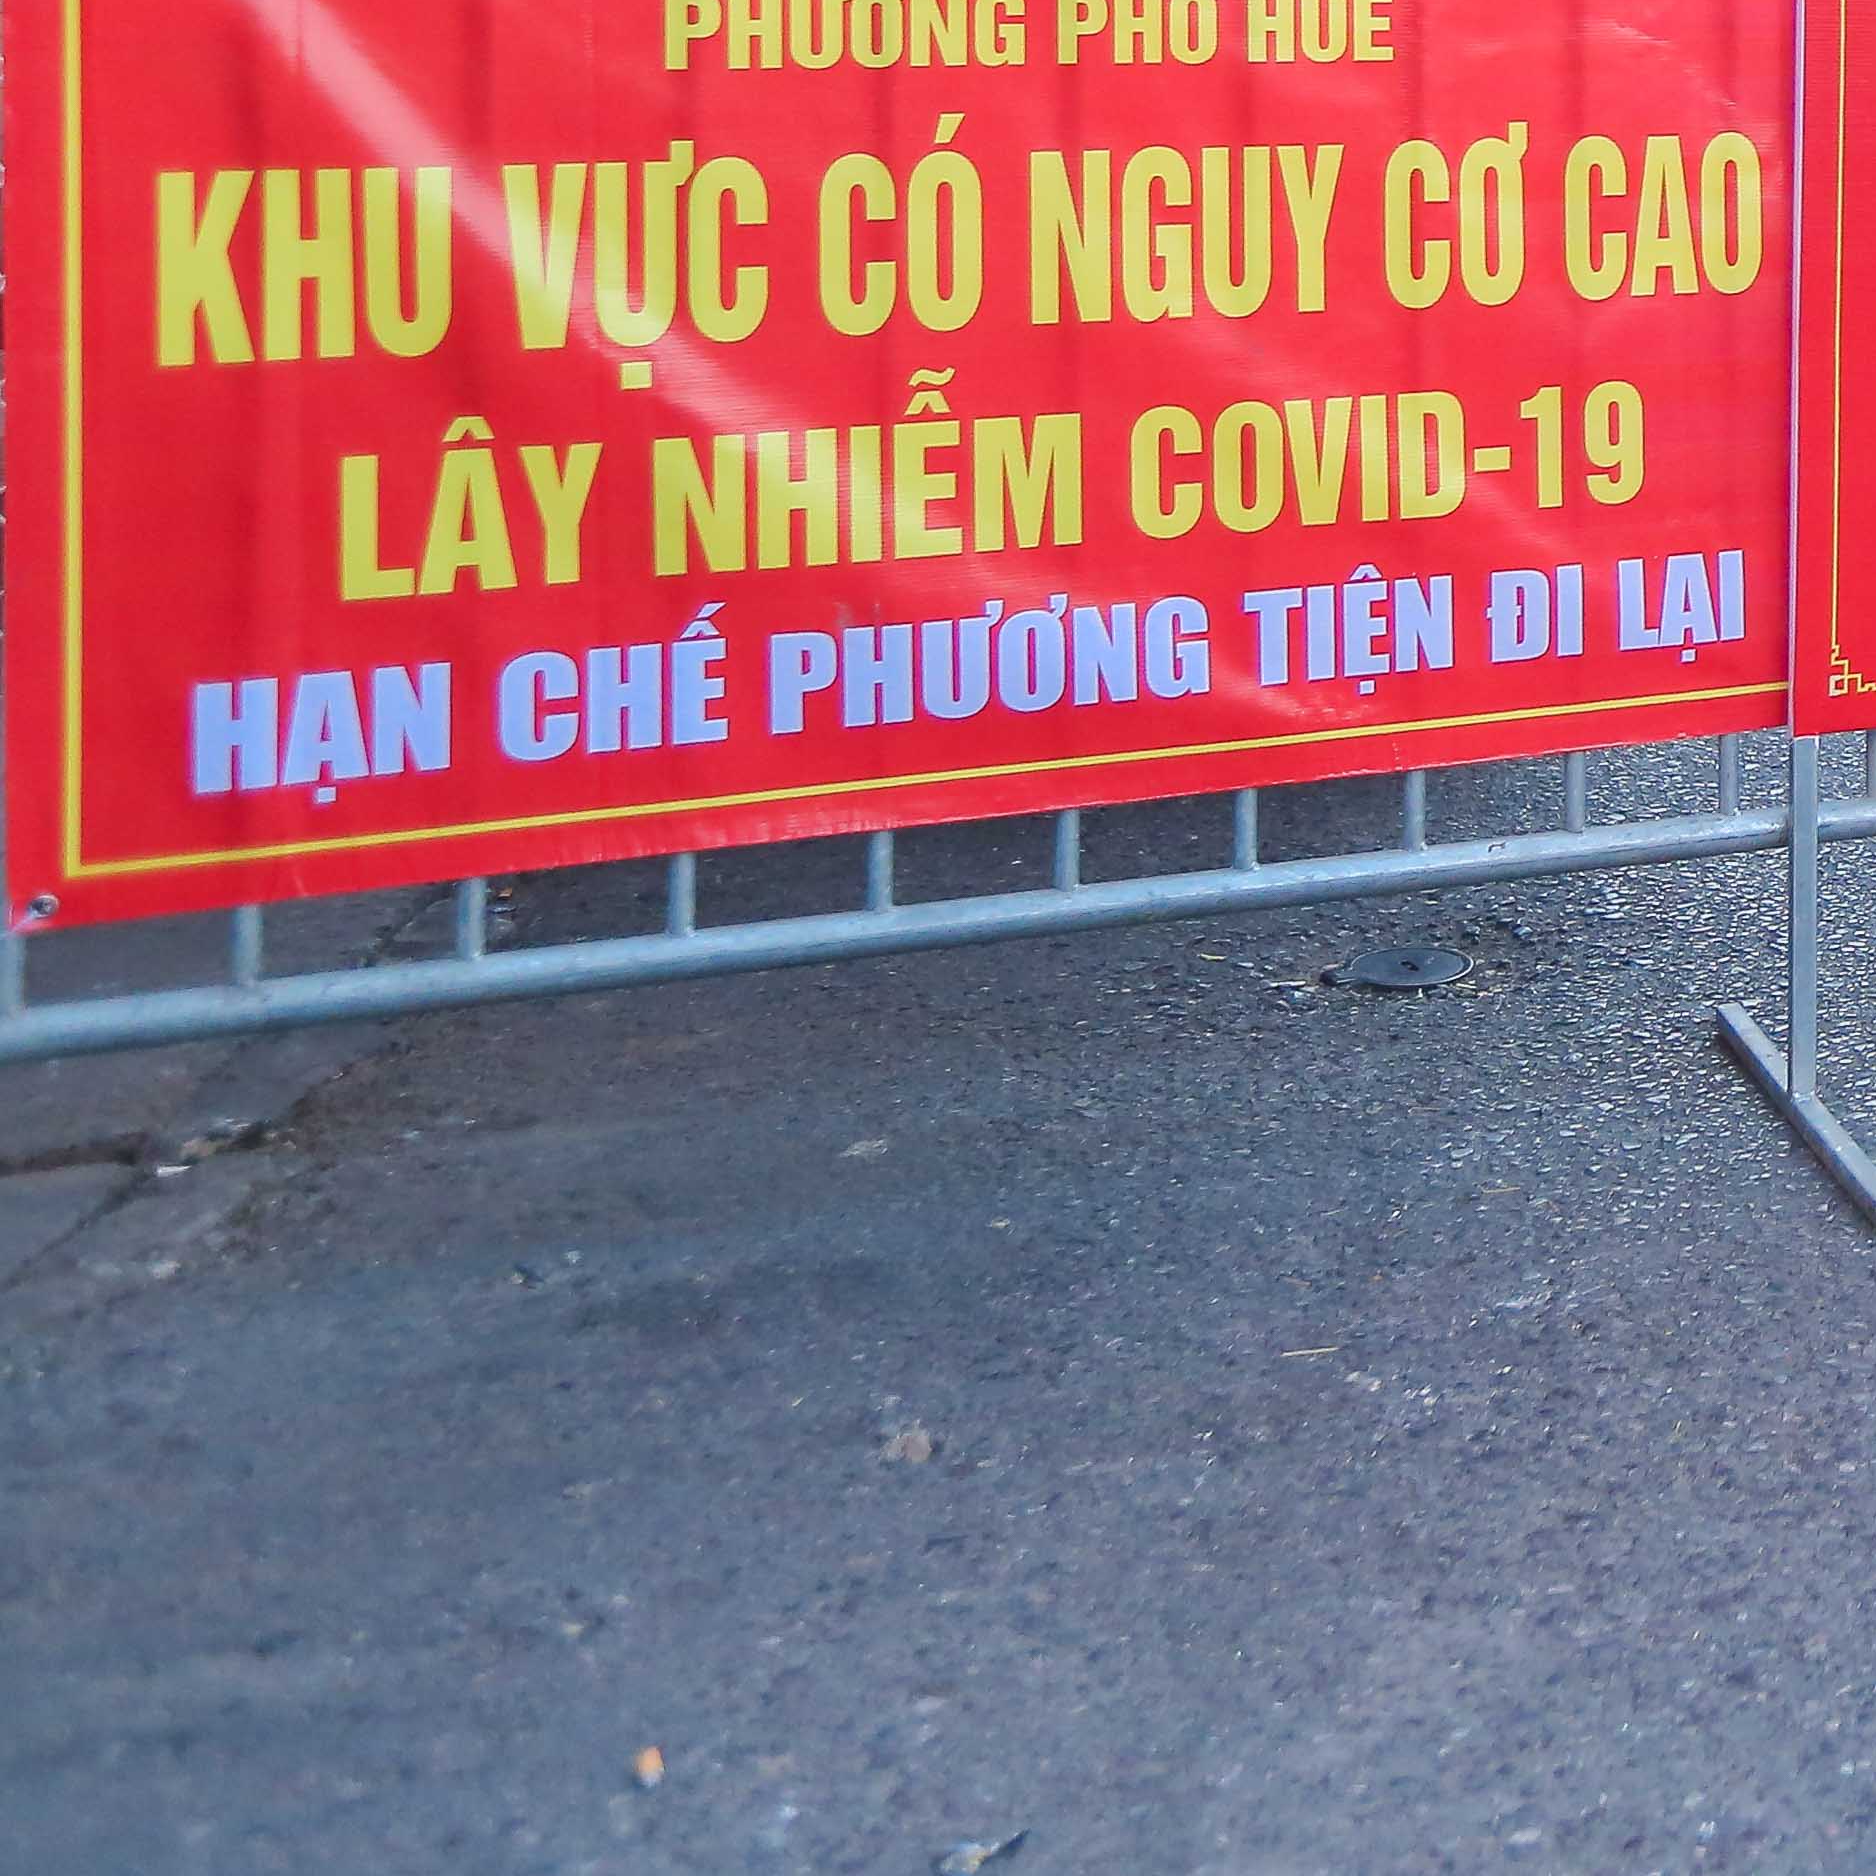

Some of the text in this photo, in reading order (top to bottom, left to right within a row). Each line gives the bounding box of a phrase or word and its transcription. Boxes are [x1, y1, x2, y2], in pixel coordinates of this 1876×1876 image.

[156, 113, 1764, 391] KHU VỰC CÓ NGUY CƠ CAO
[339, 368, 1646, 602] LÂY NHIỄM COVID-19
[191, 549, 1746, 804] HẠN CHẾ PHƯƠNG TIỆN ĐI LẠI
